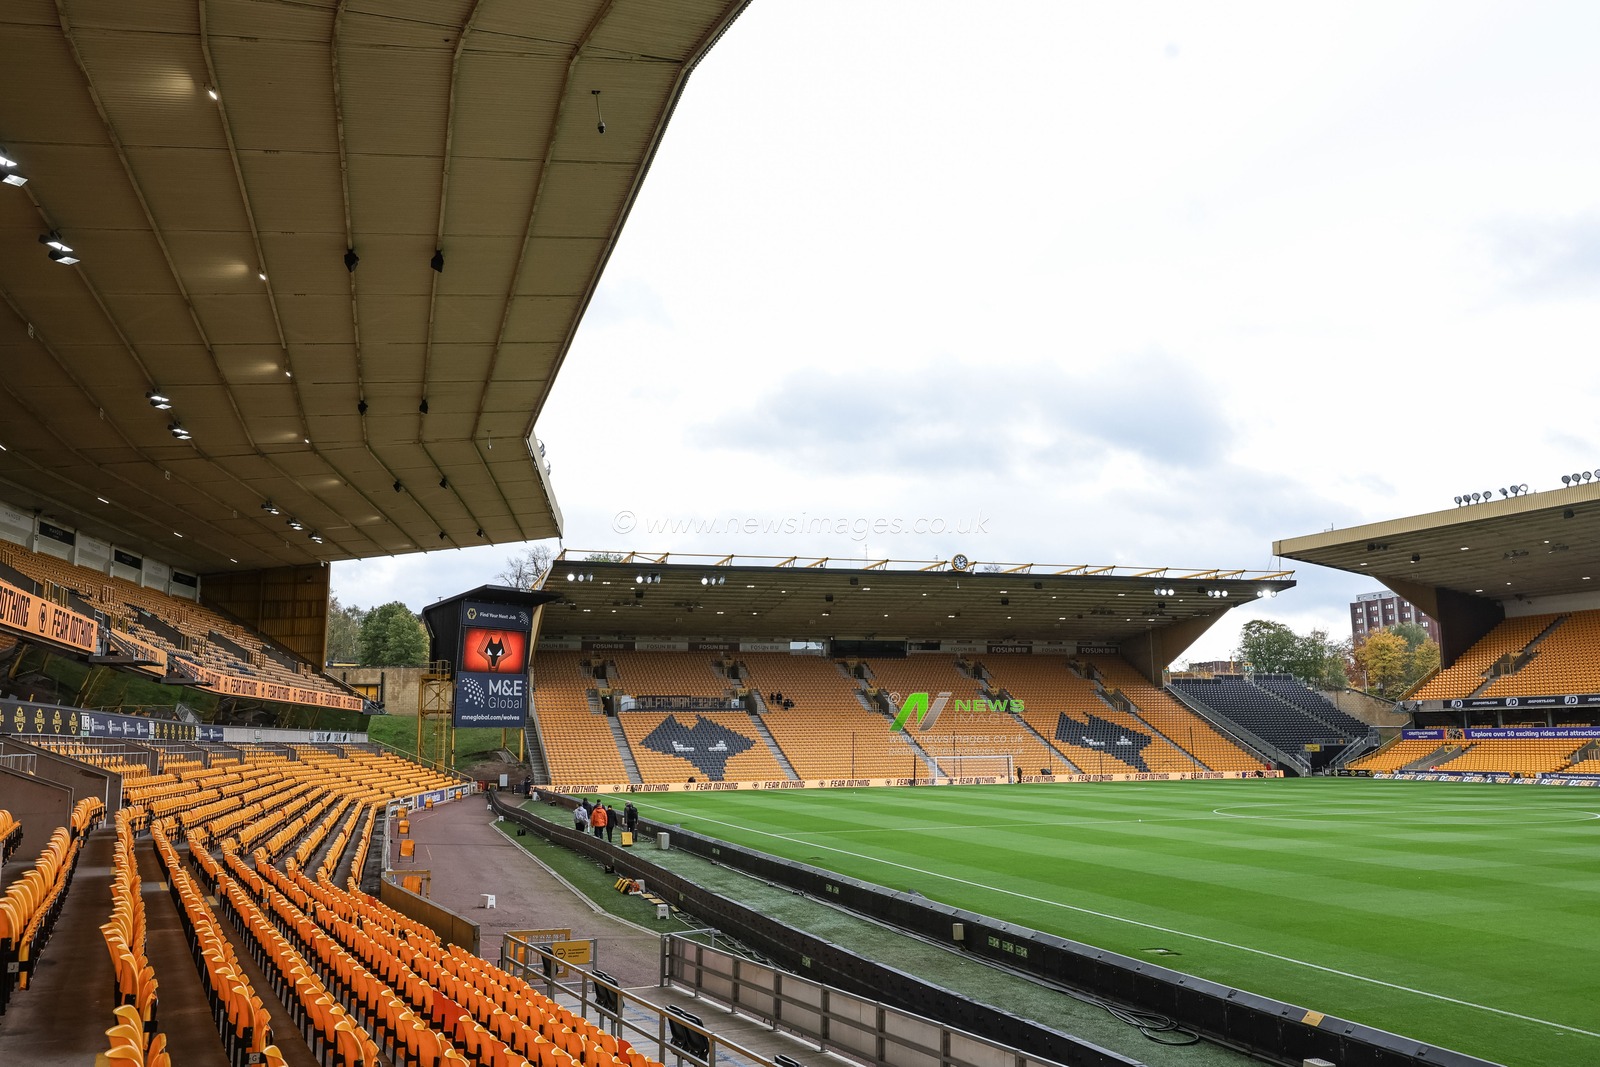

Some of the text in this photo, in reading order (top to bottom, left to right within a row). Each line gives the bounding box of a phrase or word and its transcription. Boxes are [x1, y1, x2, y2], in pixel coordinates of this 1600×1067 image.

[51, 608, 94, 648] FEAR NOTHING
[488, 679, 523, 696] M&E
[488, 696, 523, 709] Global
[1506, 697, 1518, 707] JD
[1565, 695, 1578, 705] JD
[461, 713, 520, 722] mneglobal.com/wolves
[643, 783, 670, 791] NOTHING
[695, 782, 739, 791] FEAR NOTHING
[764, 781, 806, 789] FEAR NOTHING
[846, 779, 871, 787] NOTHING
[553, 785, 599, 794] FEAR NOTHING
